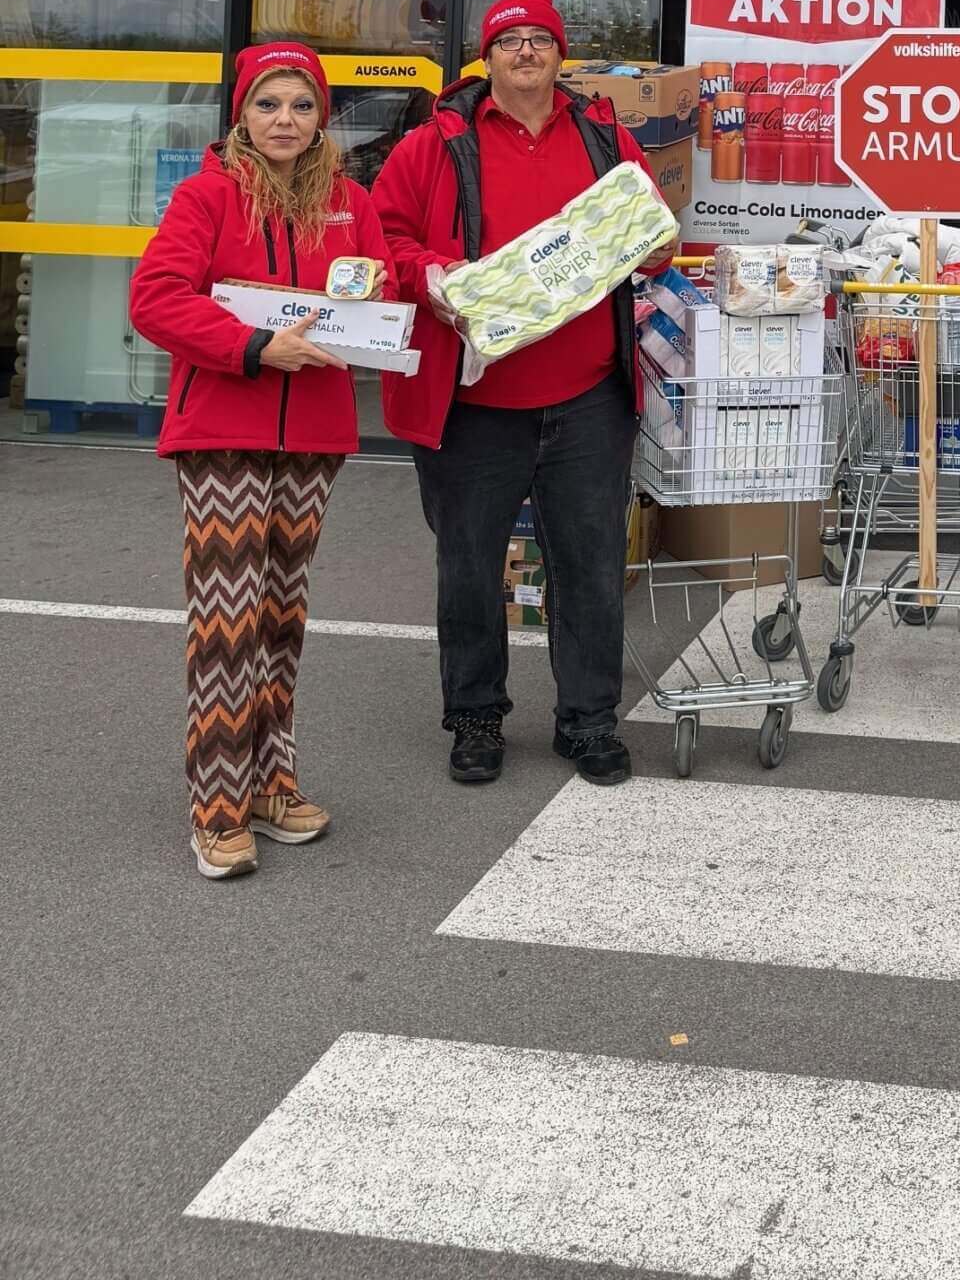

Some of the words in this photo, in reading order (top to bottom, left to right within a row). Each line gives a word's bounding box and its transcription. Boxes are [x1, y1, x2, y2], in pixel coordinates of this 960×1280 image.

[355, 66, 417, 77] AUSGANG
[700, 75, 733, 94] FANT
[713, 107, 746, 126] FANT
[694, 201, 785, 218] Coca-Cola
[530, 230, 571, 263] clever
[266, 317, 345, 334] KATZECHALEN
